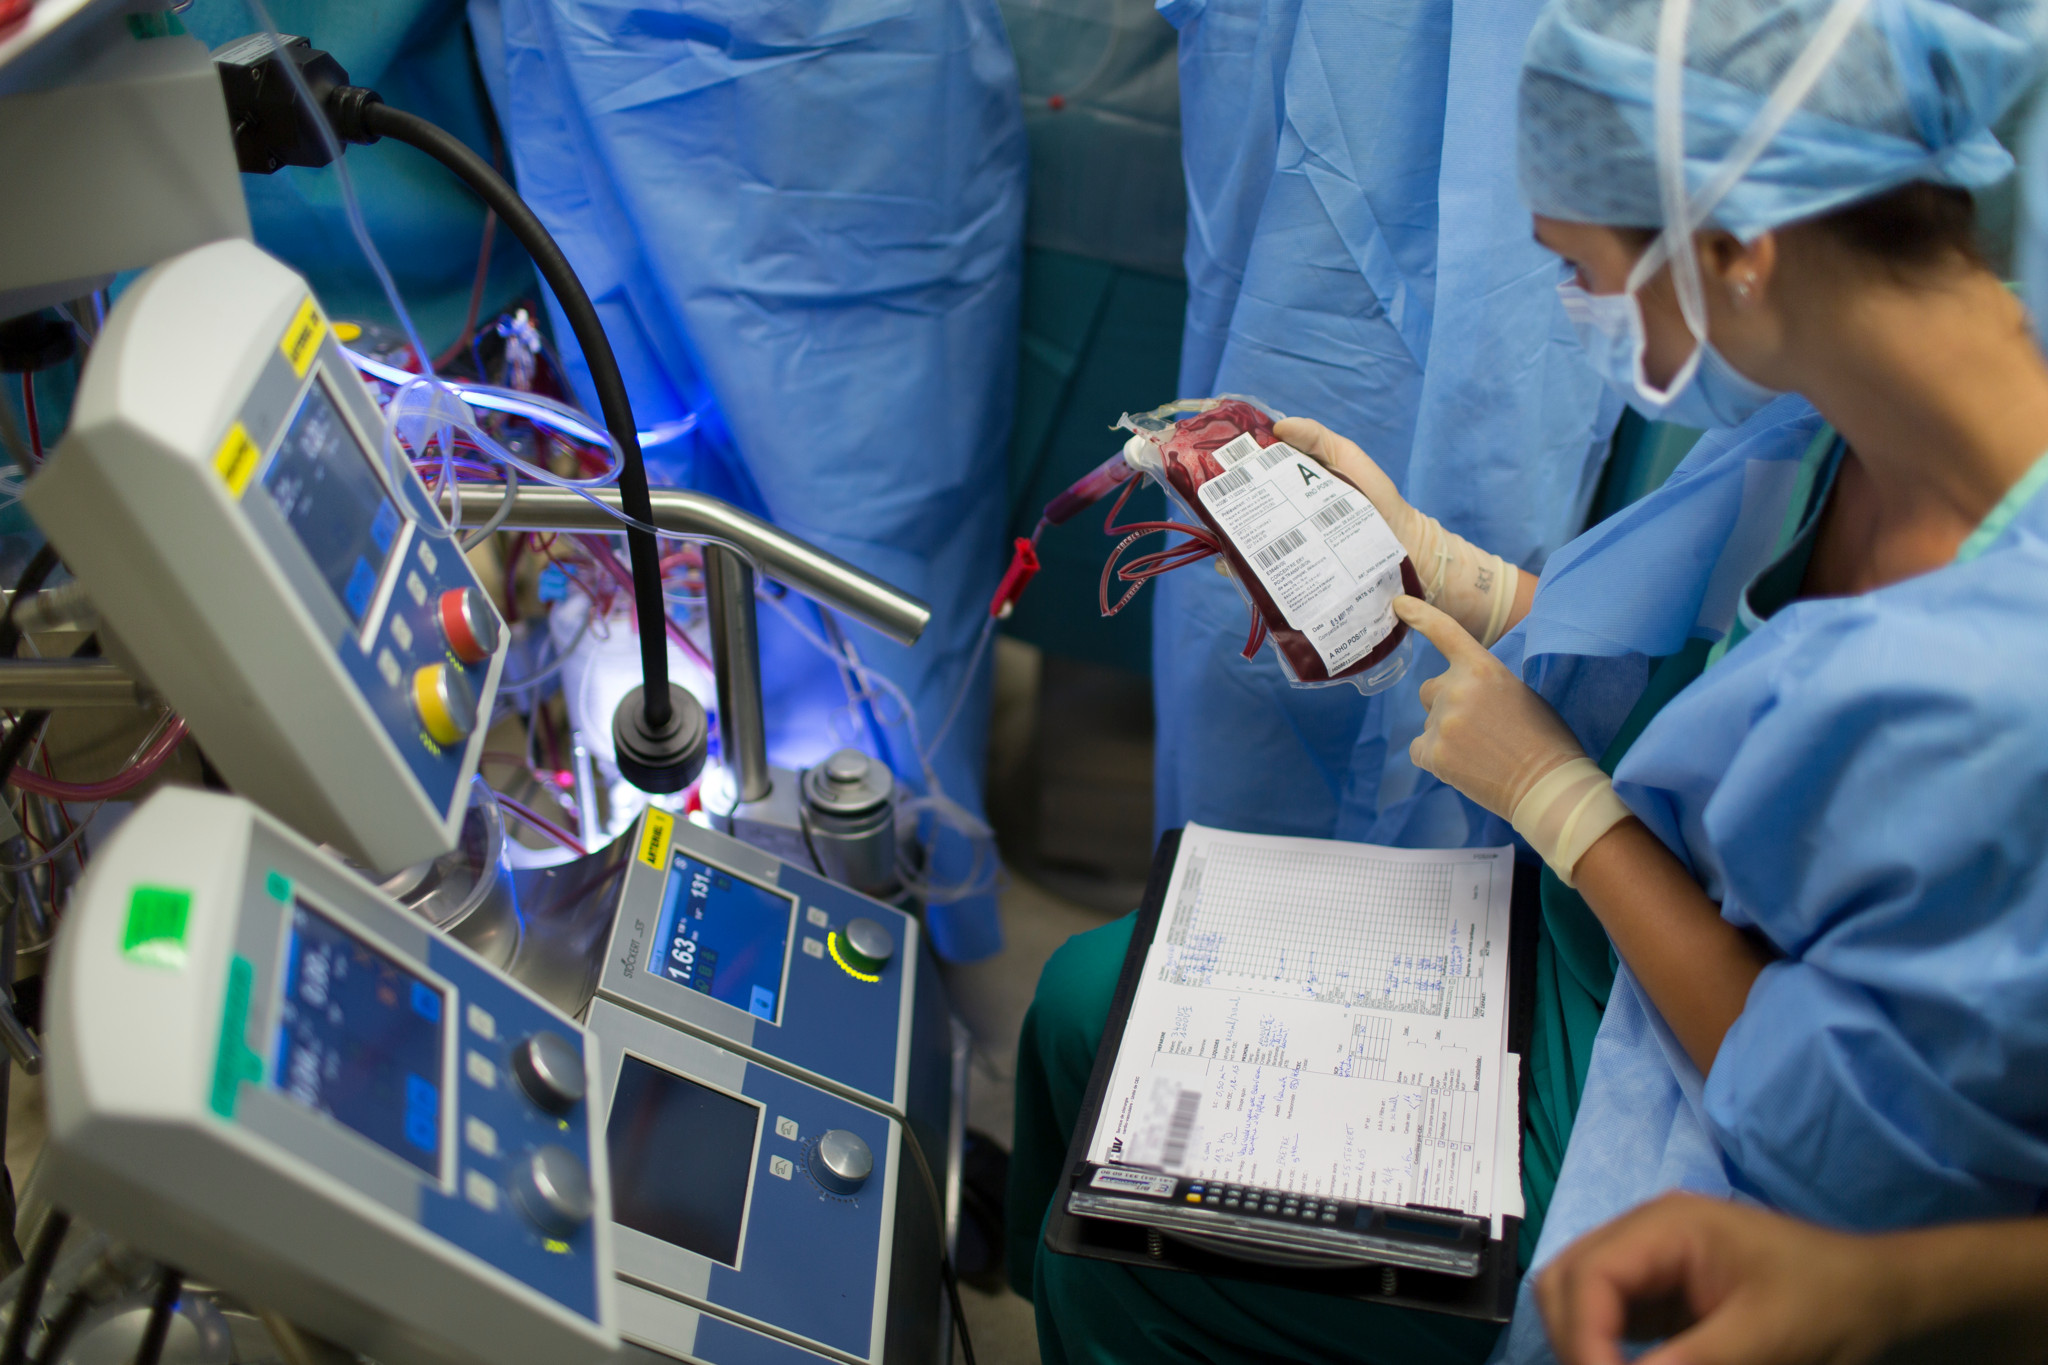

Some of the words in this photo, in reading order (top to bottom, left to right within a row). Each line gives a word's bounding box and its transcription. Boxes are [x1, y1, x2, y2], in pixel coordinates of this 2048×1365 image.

[1297, 463, 1320, 485] A
[1311, 623, 1324, 632] Date
[1347, 626, 1366, 645] POSITIF
[668, 936, 697, 980] 1.63
[691, 872, 711, 899] 131
[1211, 1039, 1219, 1058] LIQUIDES
[1241, 1043, 1249, 1061] PRIMING
